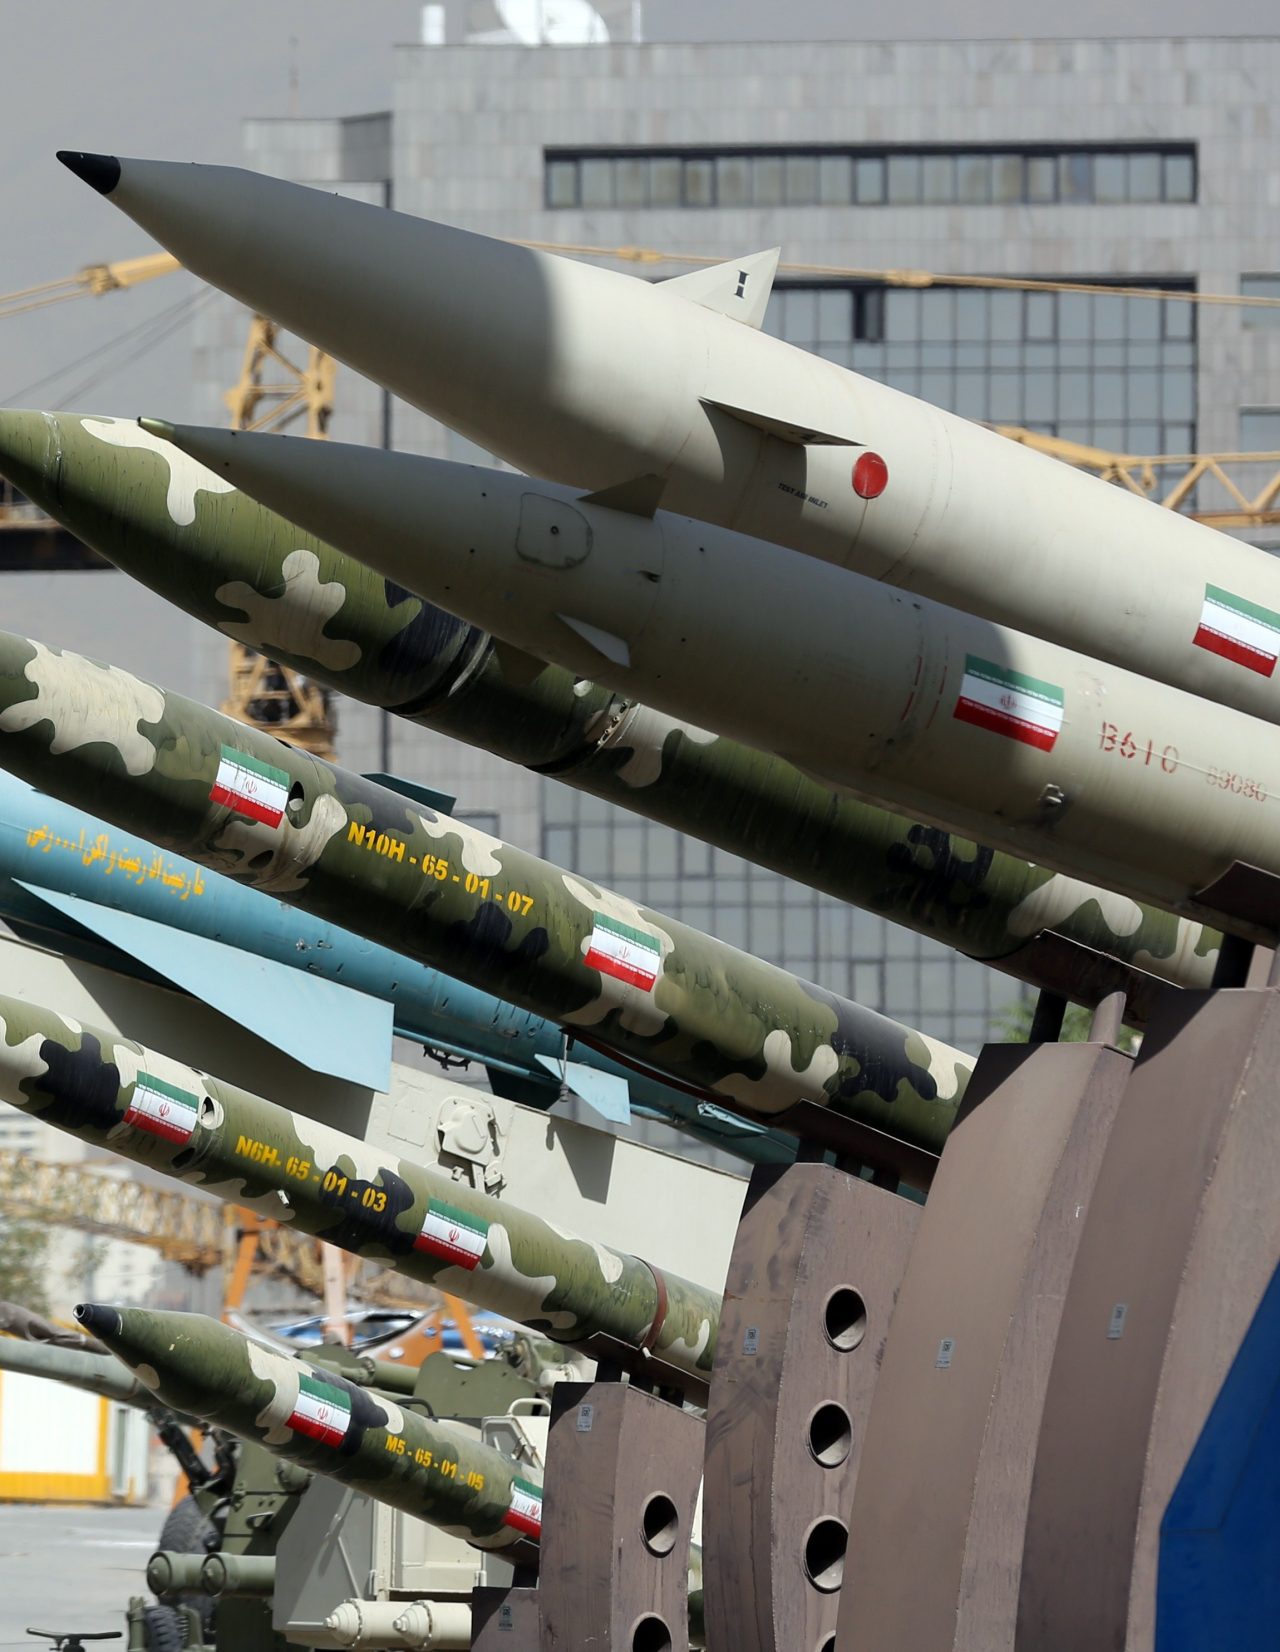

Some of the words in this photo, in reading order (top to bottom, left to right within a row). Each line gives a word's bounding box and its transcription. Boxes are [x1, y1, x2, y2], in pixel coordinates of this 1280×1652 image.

[1098, 721, 1180, 774] B610
[347, 821, 406, 863] N10H
[422, 853, 449, 881] 65
[464, 872, 490, 900] 01
[506, 890, 535, 917] 07
[323, 1171, 348, 1196] 01
[361, 1187, 388, 1213] 03
